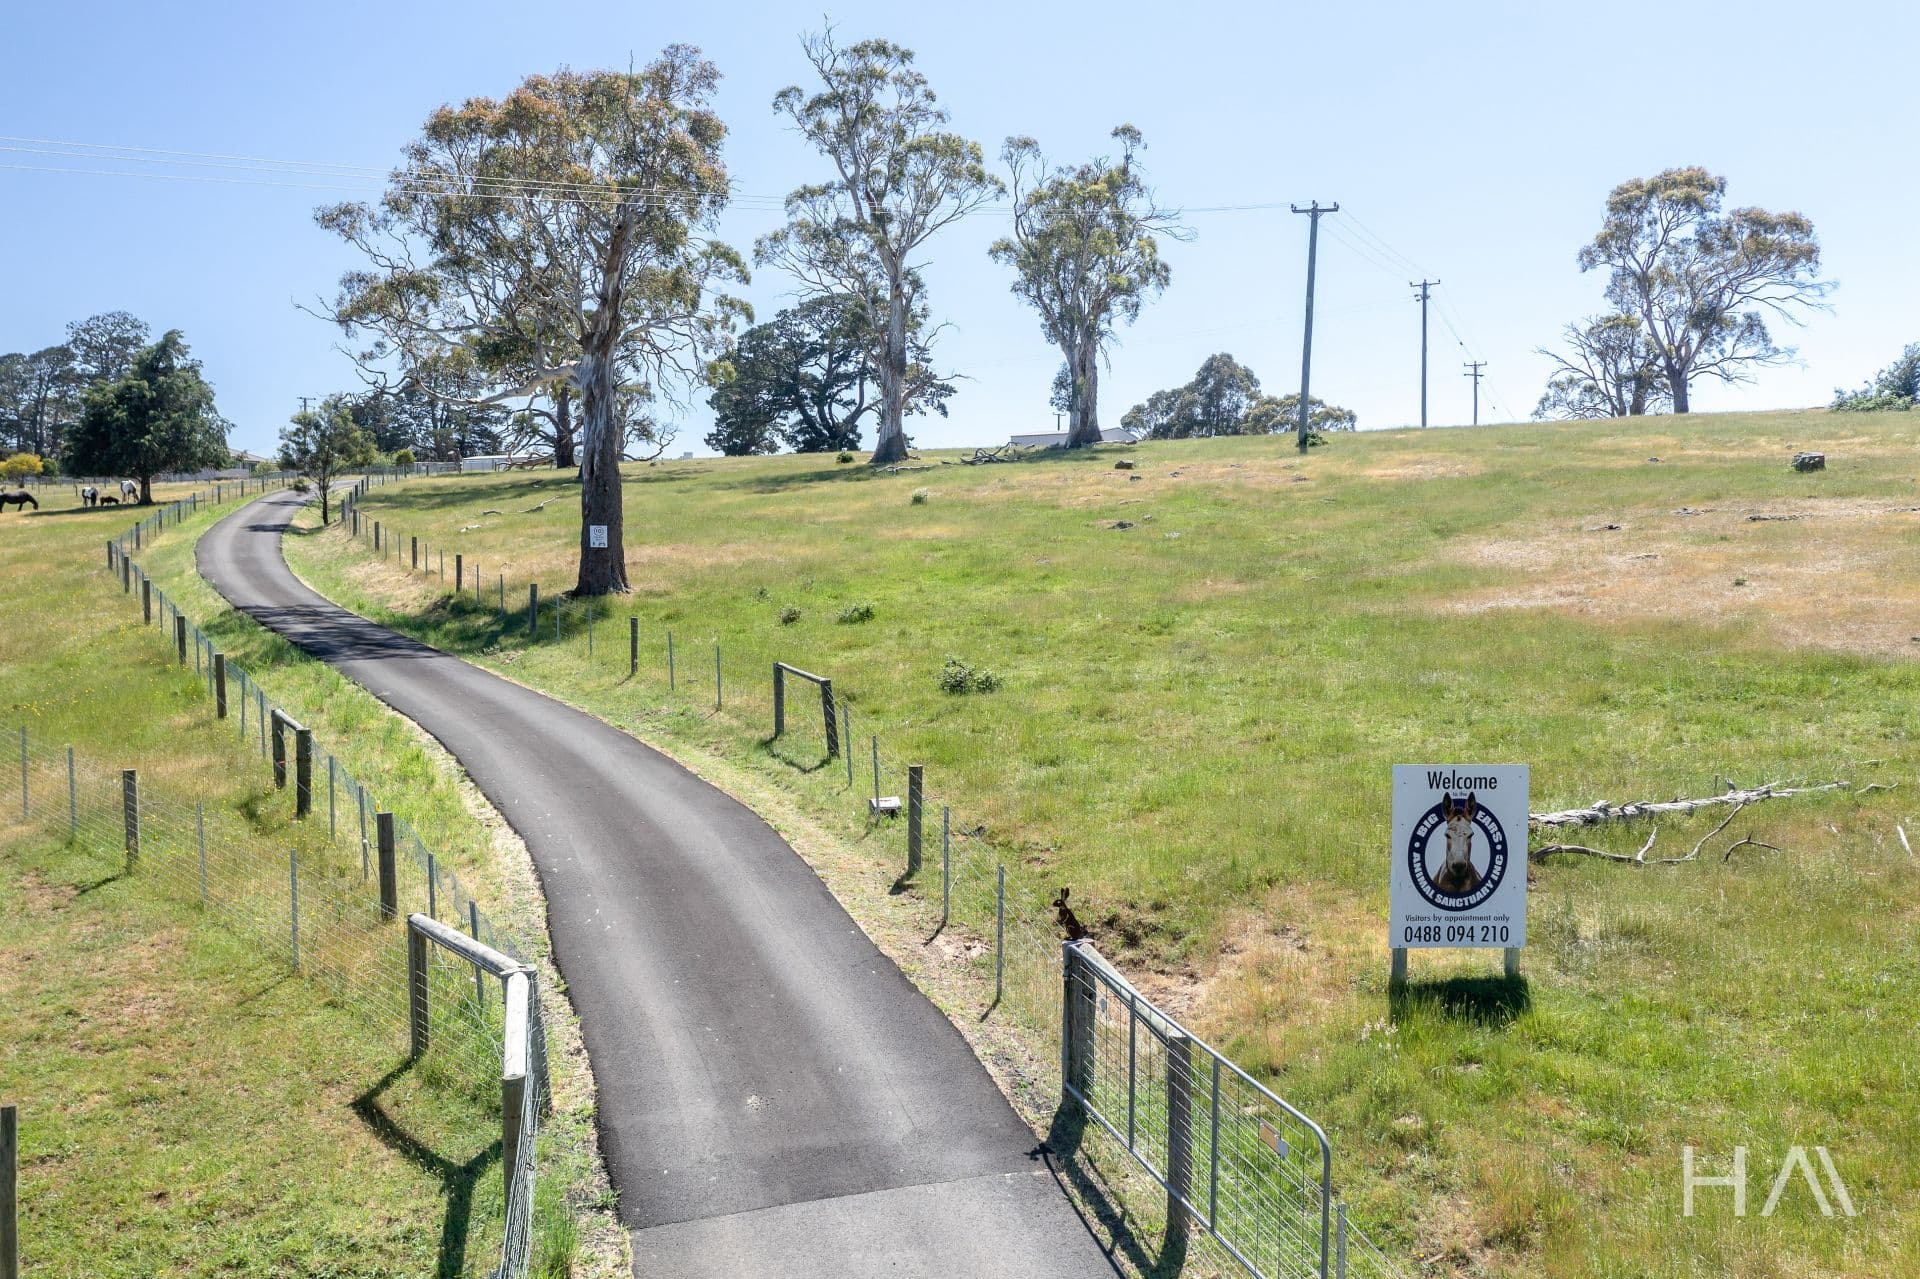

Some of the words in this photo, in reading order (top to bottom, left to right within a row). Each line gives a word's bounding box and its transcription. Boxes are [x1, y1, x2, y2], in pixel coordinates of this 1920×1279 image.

[1427, 770, 1498, 789] Welcome
[1417, 813, 1439, 837] BIG
[1476, 810, 1503, 843] EARS
[1413, 852, 1435, 899] ANIMAL
[1435, 882, 1494, 907] SANCTUARY
[1491, 854, 1504, 881] INC
[1433, 914, 1442, 923] by
[1445, 915, 1491, 923] appointment
[1493, 914, 1510, 923] only
[1404, 926, 1441, 942] 0488
[1447, 926, 1475, 942] 094
[1481, 926, 1509, 942] 210
